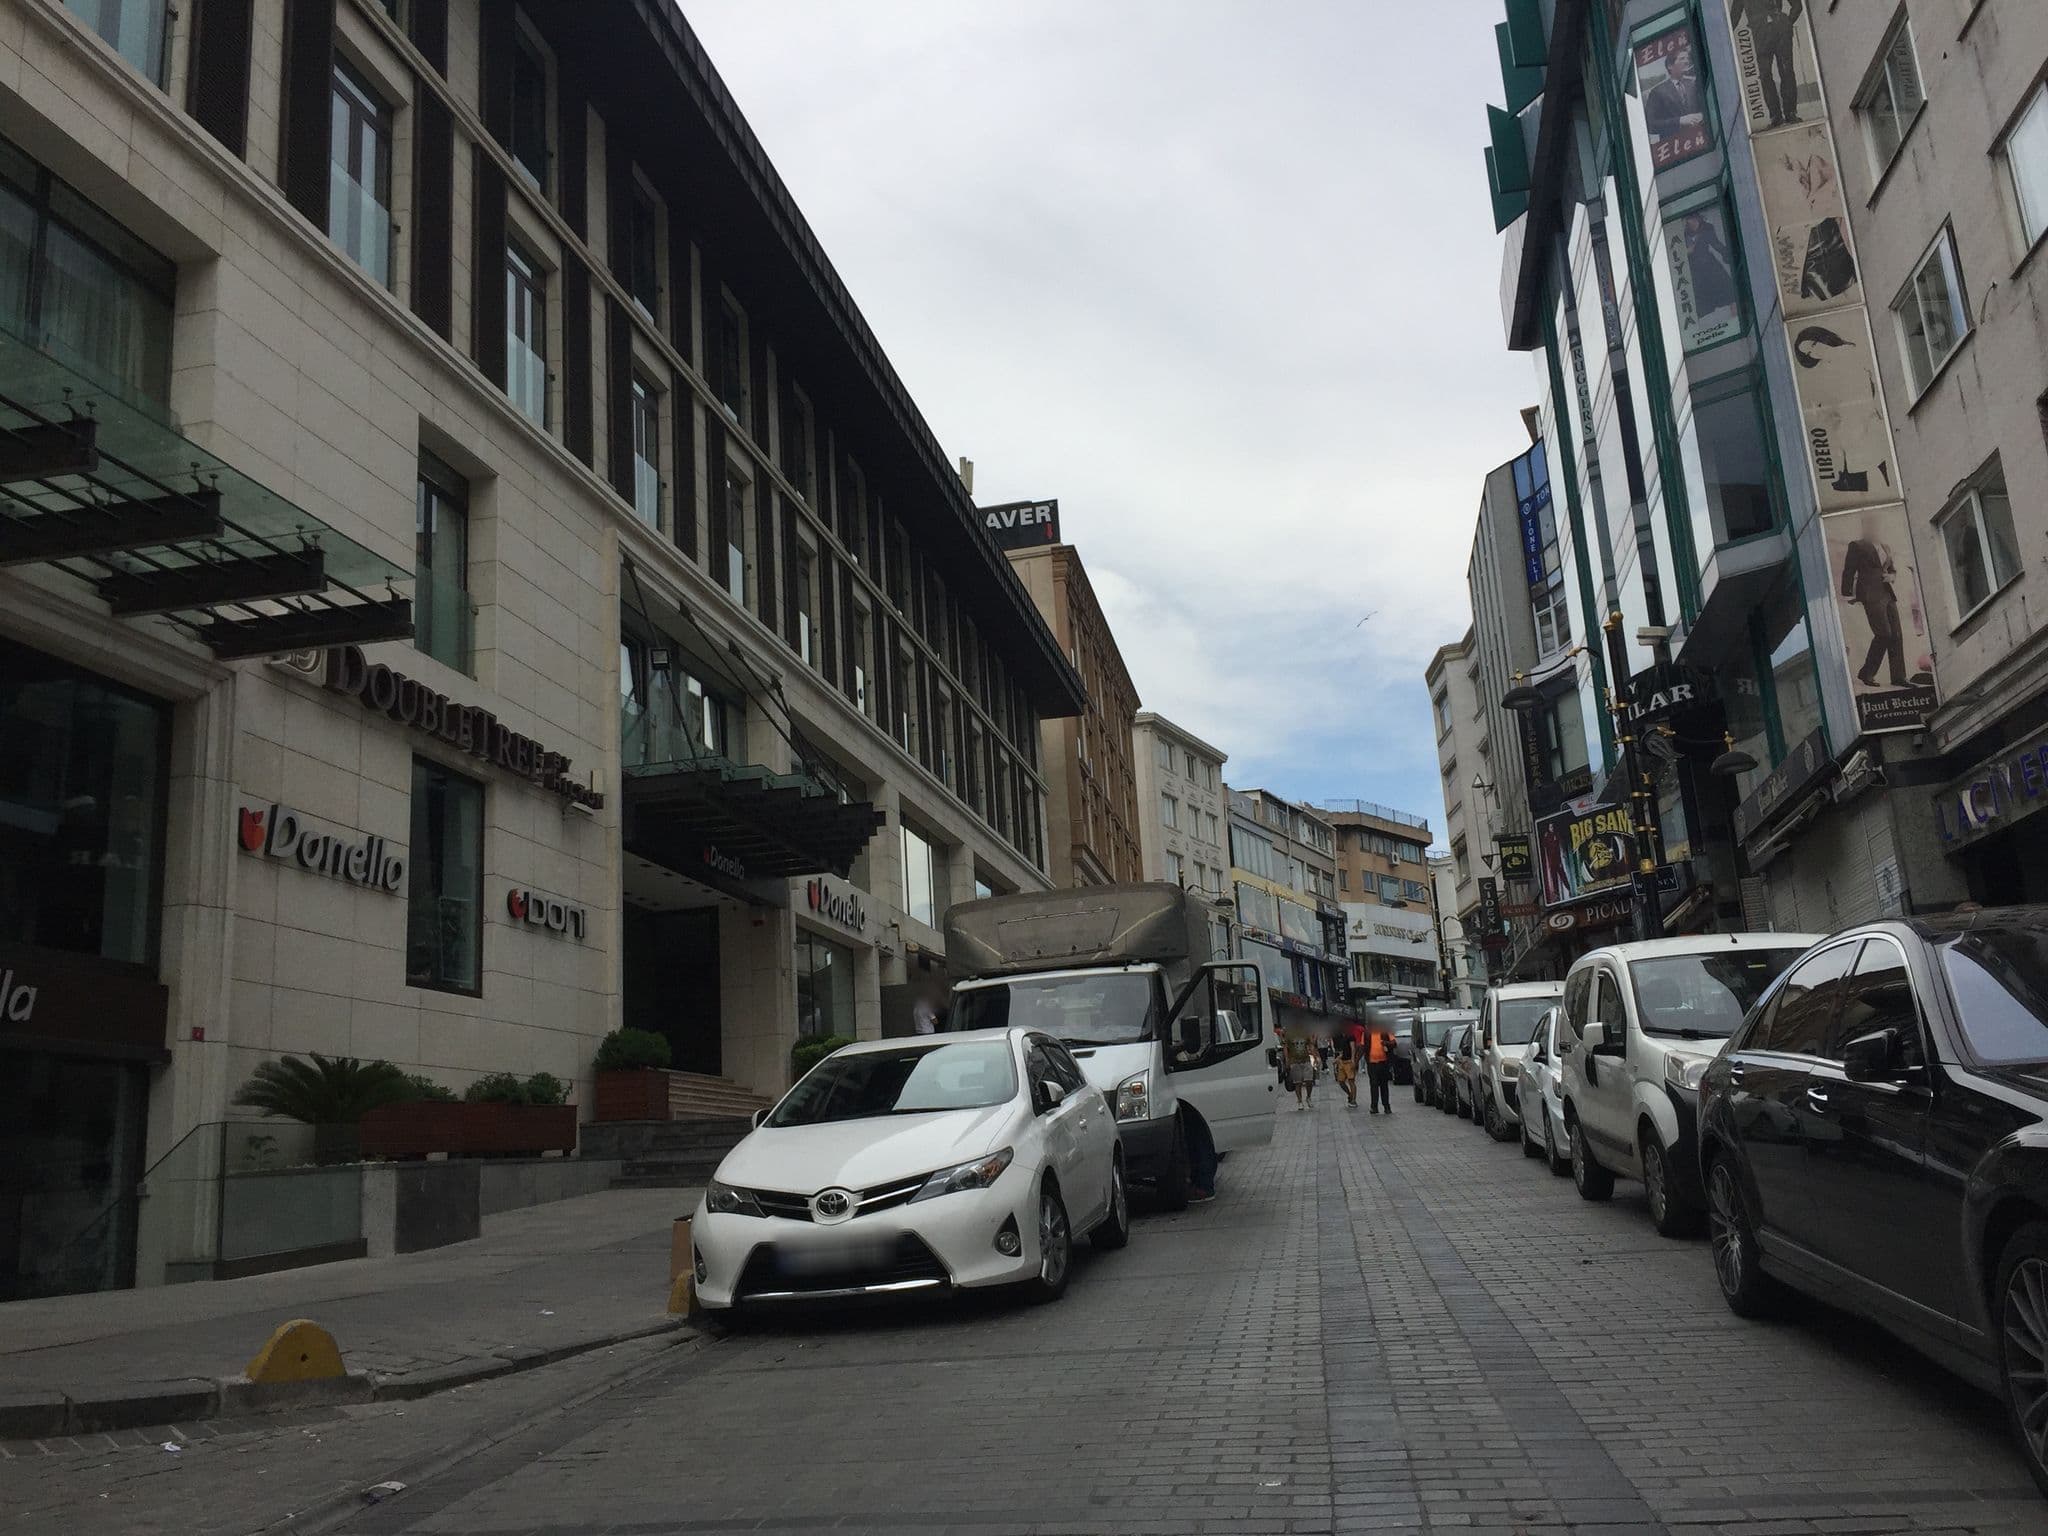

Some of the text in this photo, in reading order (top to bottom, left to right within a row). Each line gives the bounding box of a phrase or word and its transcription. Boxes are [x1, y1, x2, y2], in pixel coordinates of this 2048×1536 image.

[1739, 28, 1765, 120] DANIEL REGAZZO
[1811, 427, 1836, 480] LIBERO
[1861, 695, 1931, 717] Paul Becker
[1569, 817, 1594, 854] BIG
